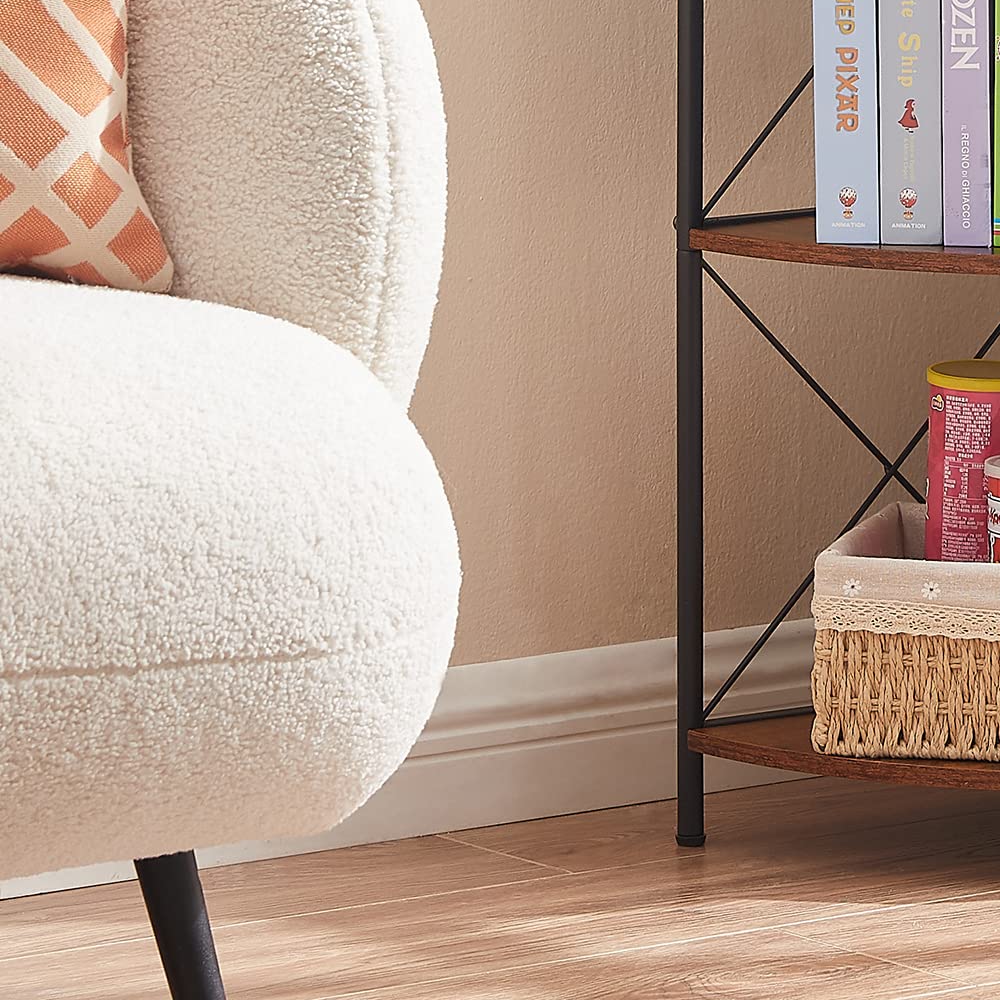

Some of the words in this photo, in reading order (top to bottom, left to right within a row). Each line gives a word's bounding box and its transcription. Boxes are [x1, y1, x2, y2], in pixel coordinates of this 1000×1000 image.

[898, 32, 921, 88] Ship
[835, 47, 859, 132] PIXAR
[961, 132, 970, 169] REGNO
[961, 179, 971, 229] GHIACCIO
